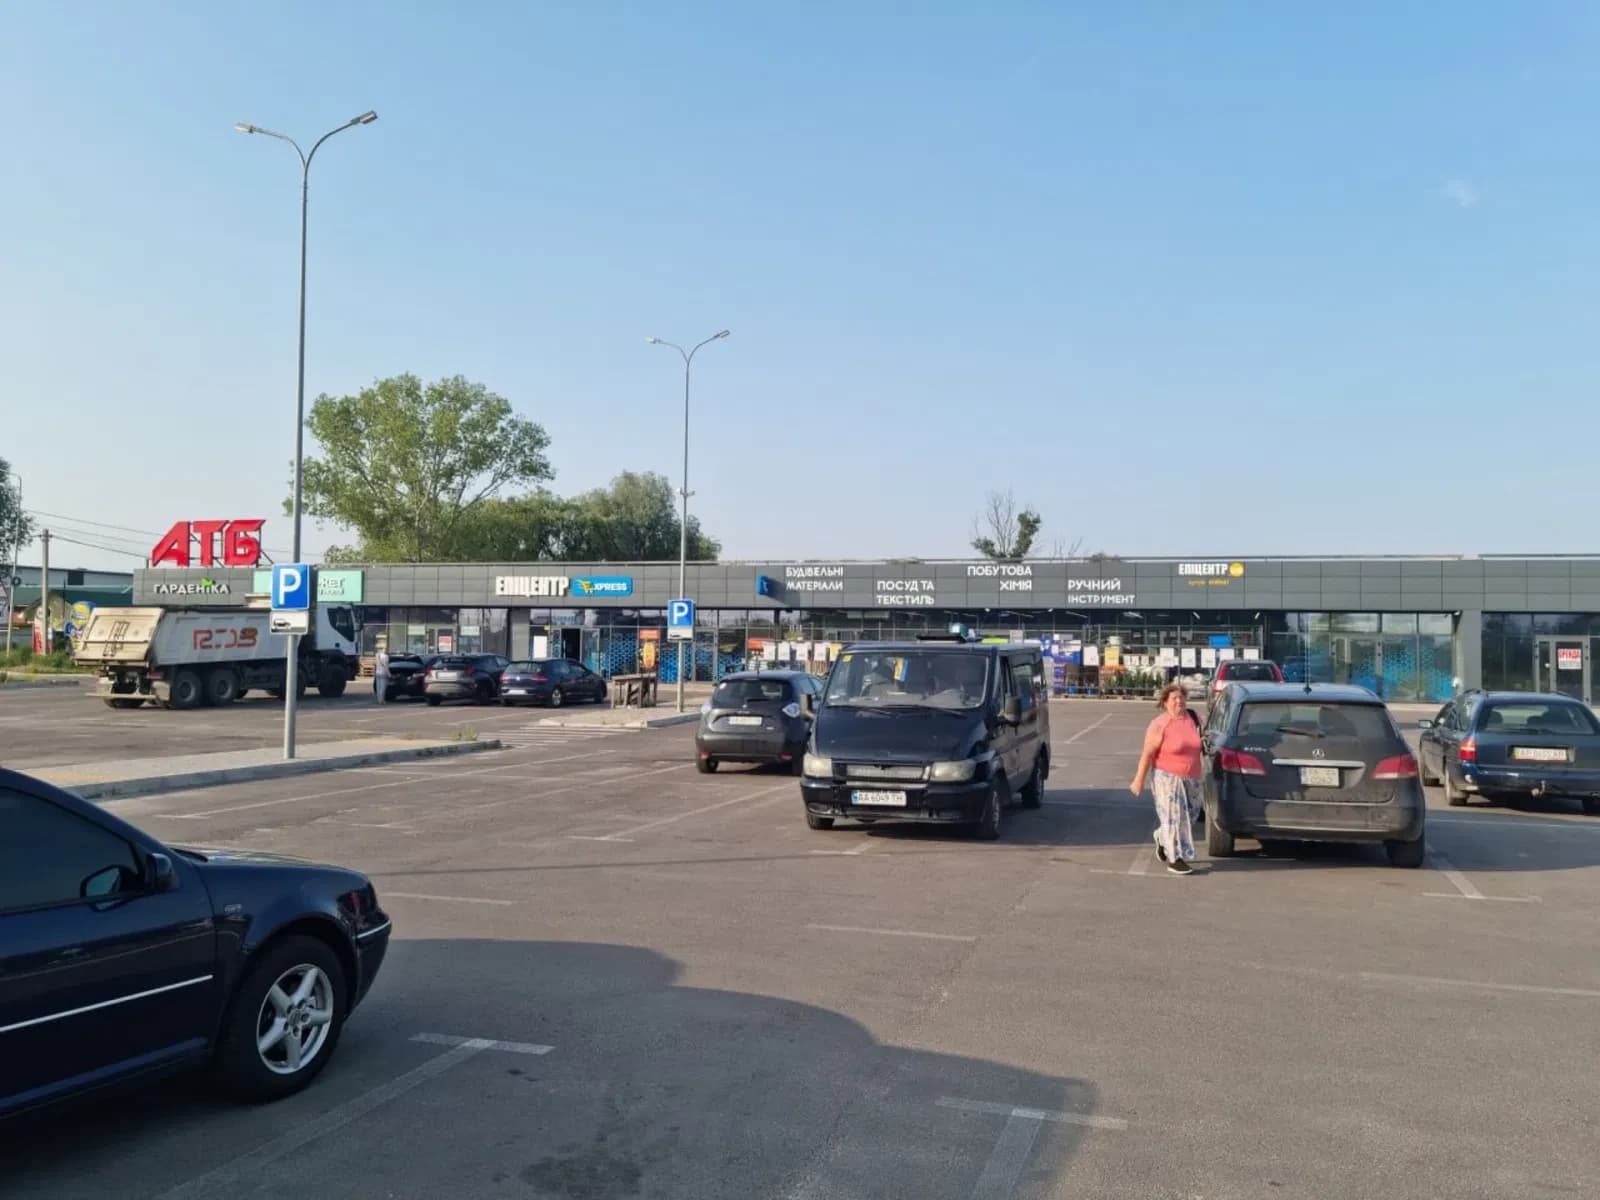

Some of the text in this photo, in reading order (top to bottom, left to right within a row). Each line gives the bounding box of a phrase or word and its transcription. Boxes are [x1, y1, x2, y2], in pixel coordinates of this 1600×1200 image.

[152, 520, 266, 567] АТБ
[786, 567, 844, 578] БУДІВЕЛЬНІ
[967, 566, 1033, 577] ПОБУТОВА
[1178, 563, 1229, 577] ЕПІЦЕНТР
[153, 583, 231, 595] ГАРДЕНІКА
[495, 576, 569, 597] ЕПІЦЕНТР
[786, 580, 844, 590] МАТЕРІАЛИ
[877, 580, 935, 593] ПОСУД ТА
[999, 580, 1033, 591] ХІМІЯ
[1068, 579, 1121, 591] РУЧНИЙ
[877, 595, 935, 606] ТЕКСТИЛЬ
[1068, 594, 1135, 604] ІНСТРУМЕНТ
